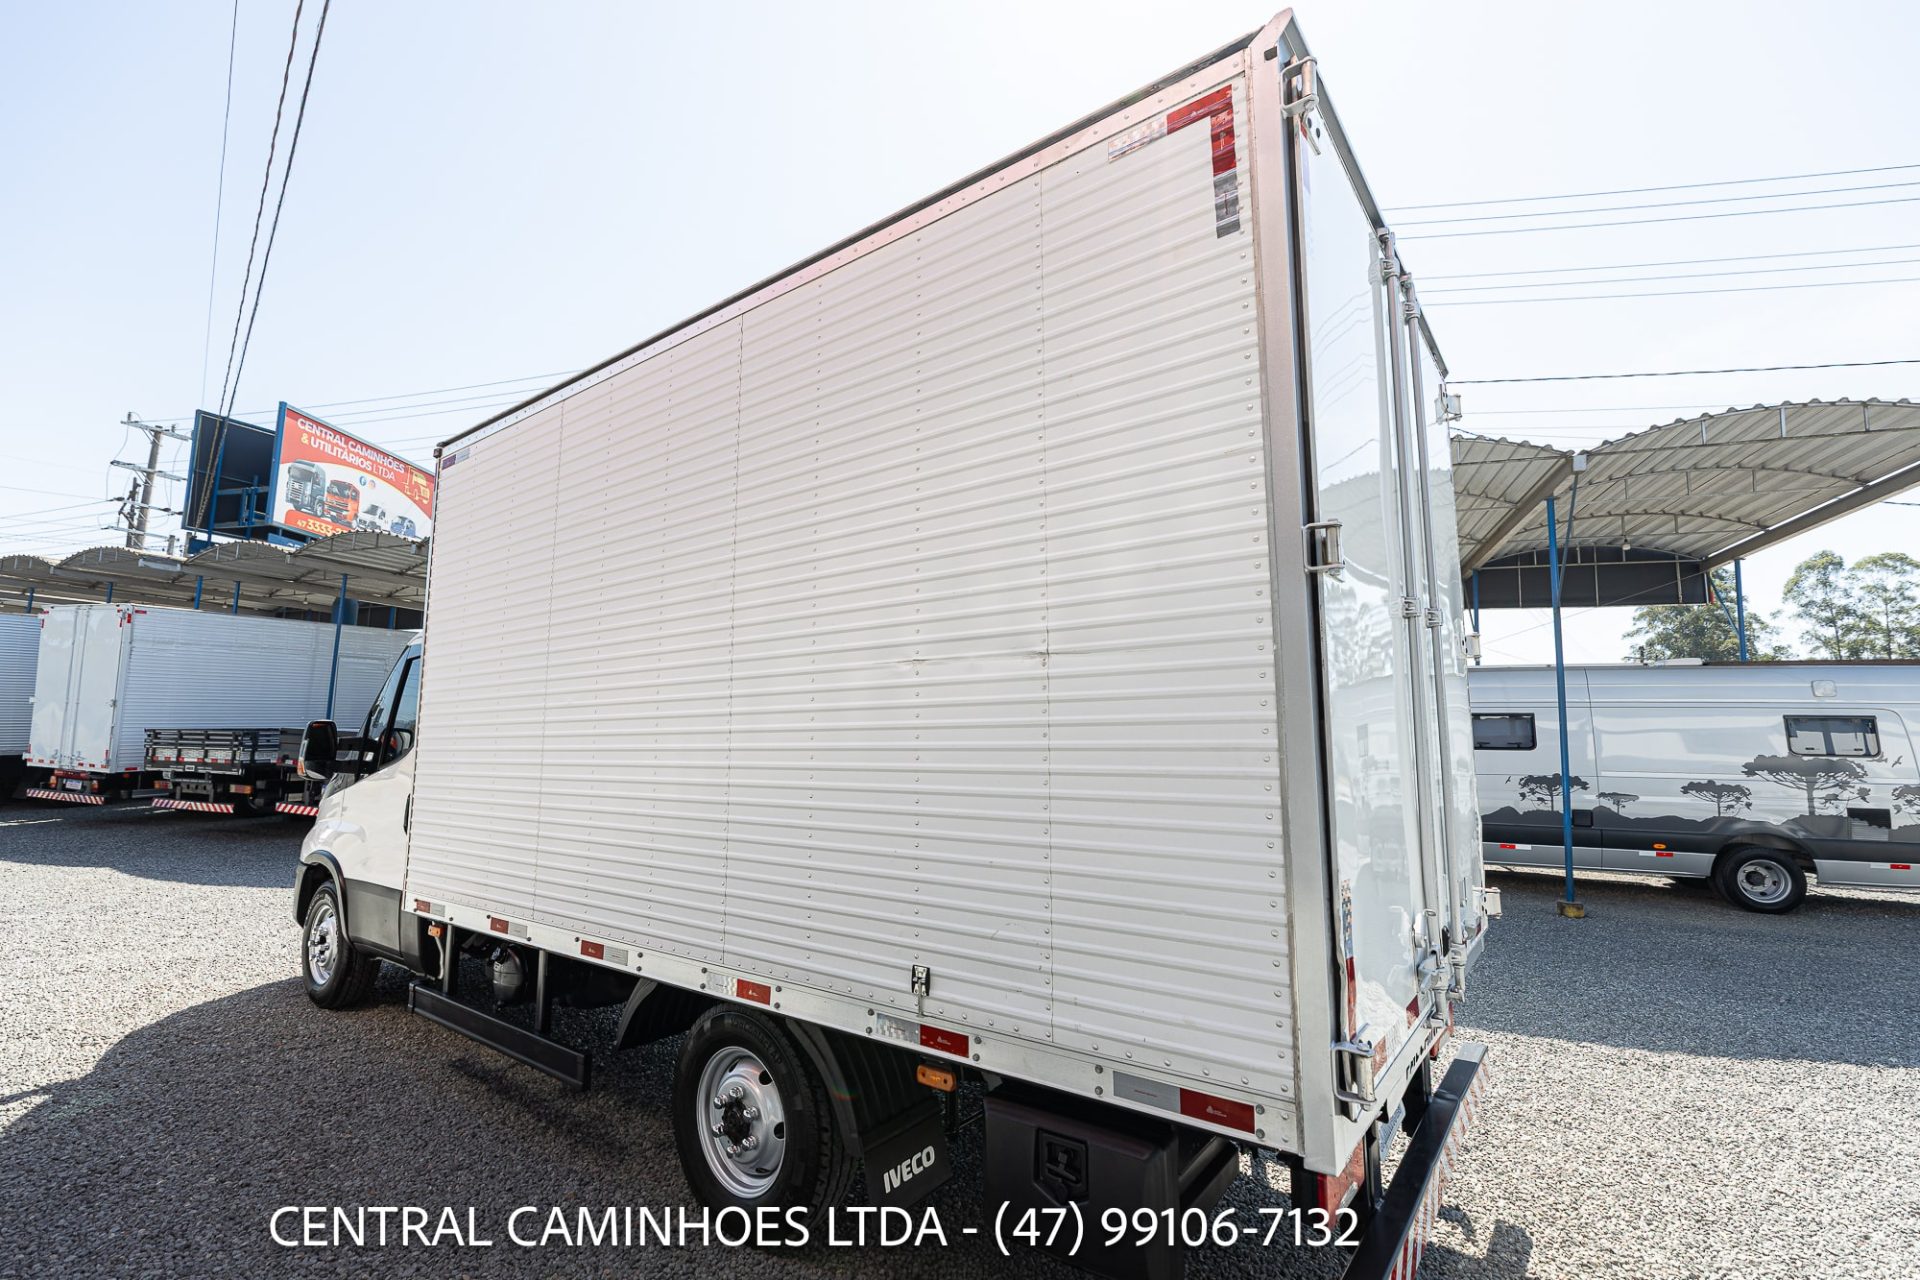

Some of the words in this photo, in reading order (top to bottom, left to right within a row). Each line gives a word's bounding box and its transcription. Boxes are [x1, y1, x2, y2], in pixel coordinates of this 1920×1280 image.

[297, 418, 346, 448] CENTRAL
[348, 440, 405, 474] CAMINHÕES
[301, 432, 309, 445] &
[310, 436, 373, 471] UTILITÁRIOS
[373, 465, 396, 482] LTDA
[883, 1145, 935, 1194] IVECO
